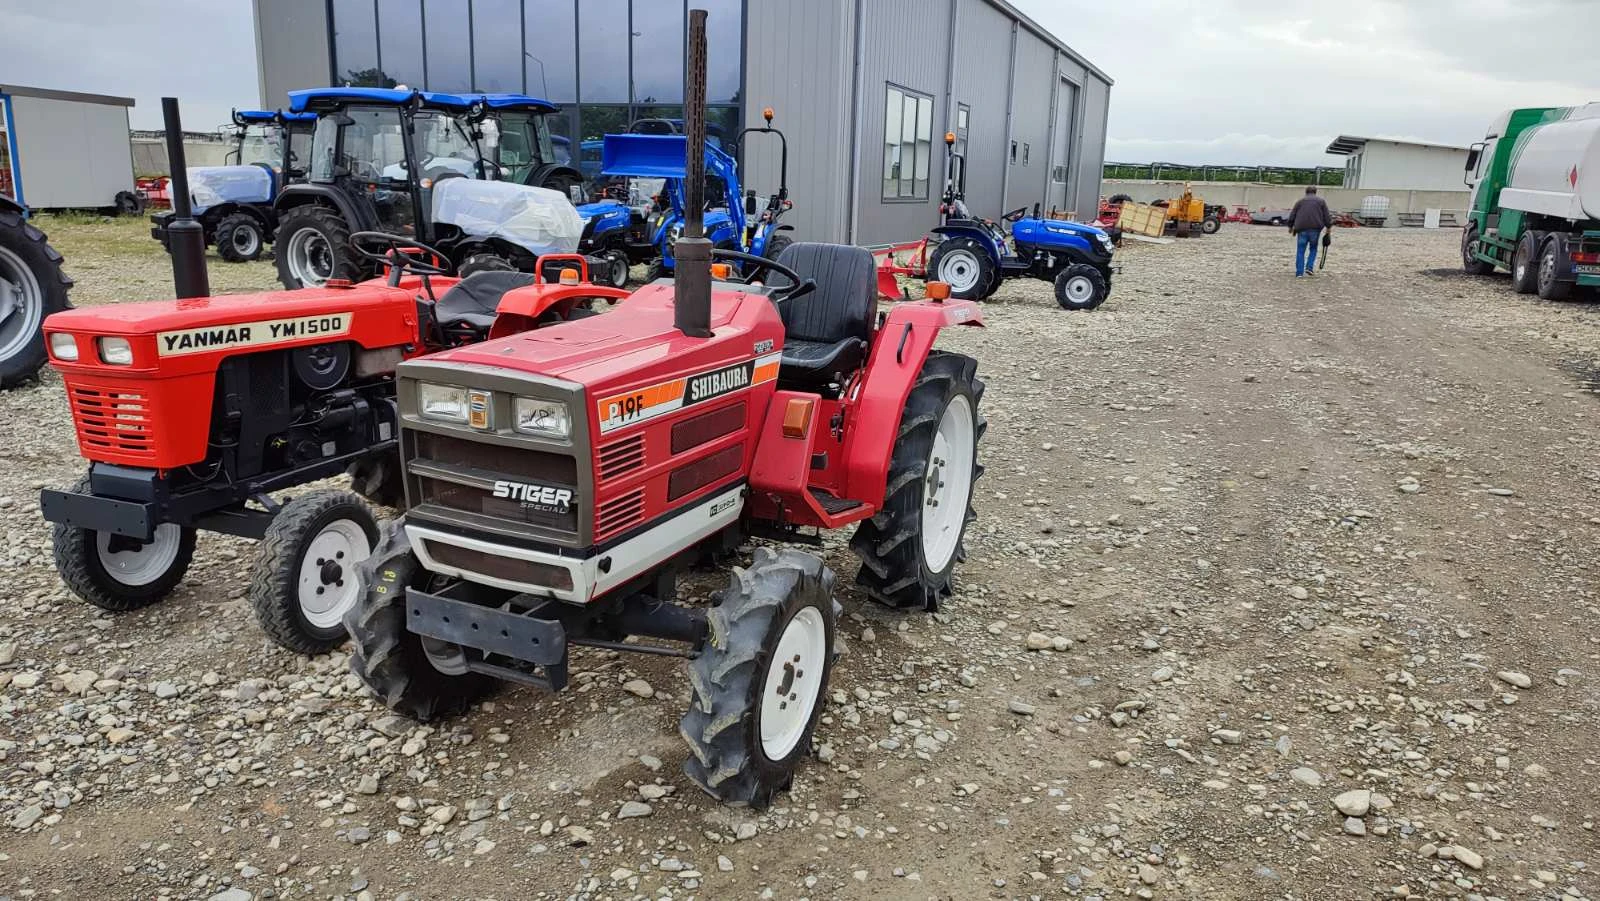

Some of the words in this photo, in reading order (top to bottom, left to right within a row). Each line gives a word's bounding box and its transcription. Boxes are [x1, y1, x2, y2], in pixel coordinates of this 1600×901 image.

[164, 327, 251, 350] YANMAR
[270, 317, 342, 338] YM1500
[691, 366, 748, 400] SHIBAURA
[608, 395, 644, 426] P19F
[493, 480, 572, 507] STIGER
[520, 503, 567, 514] SPECIAL
